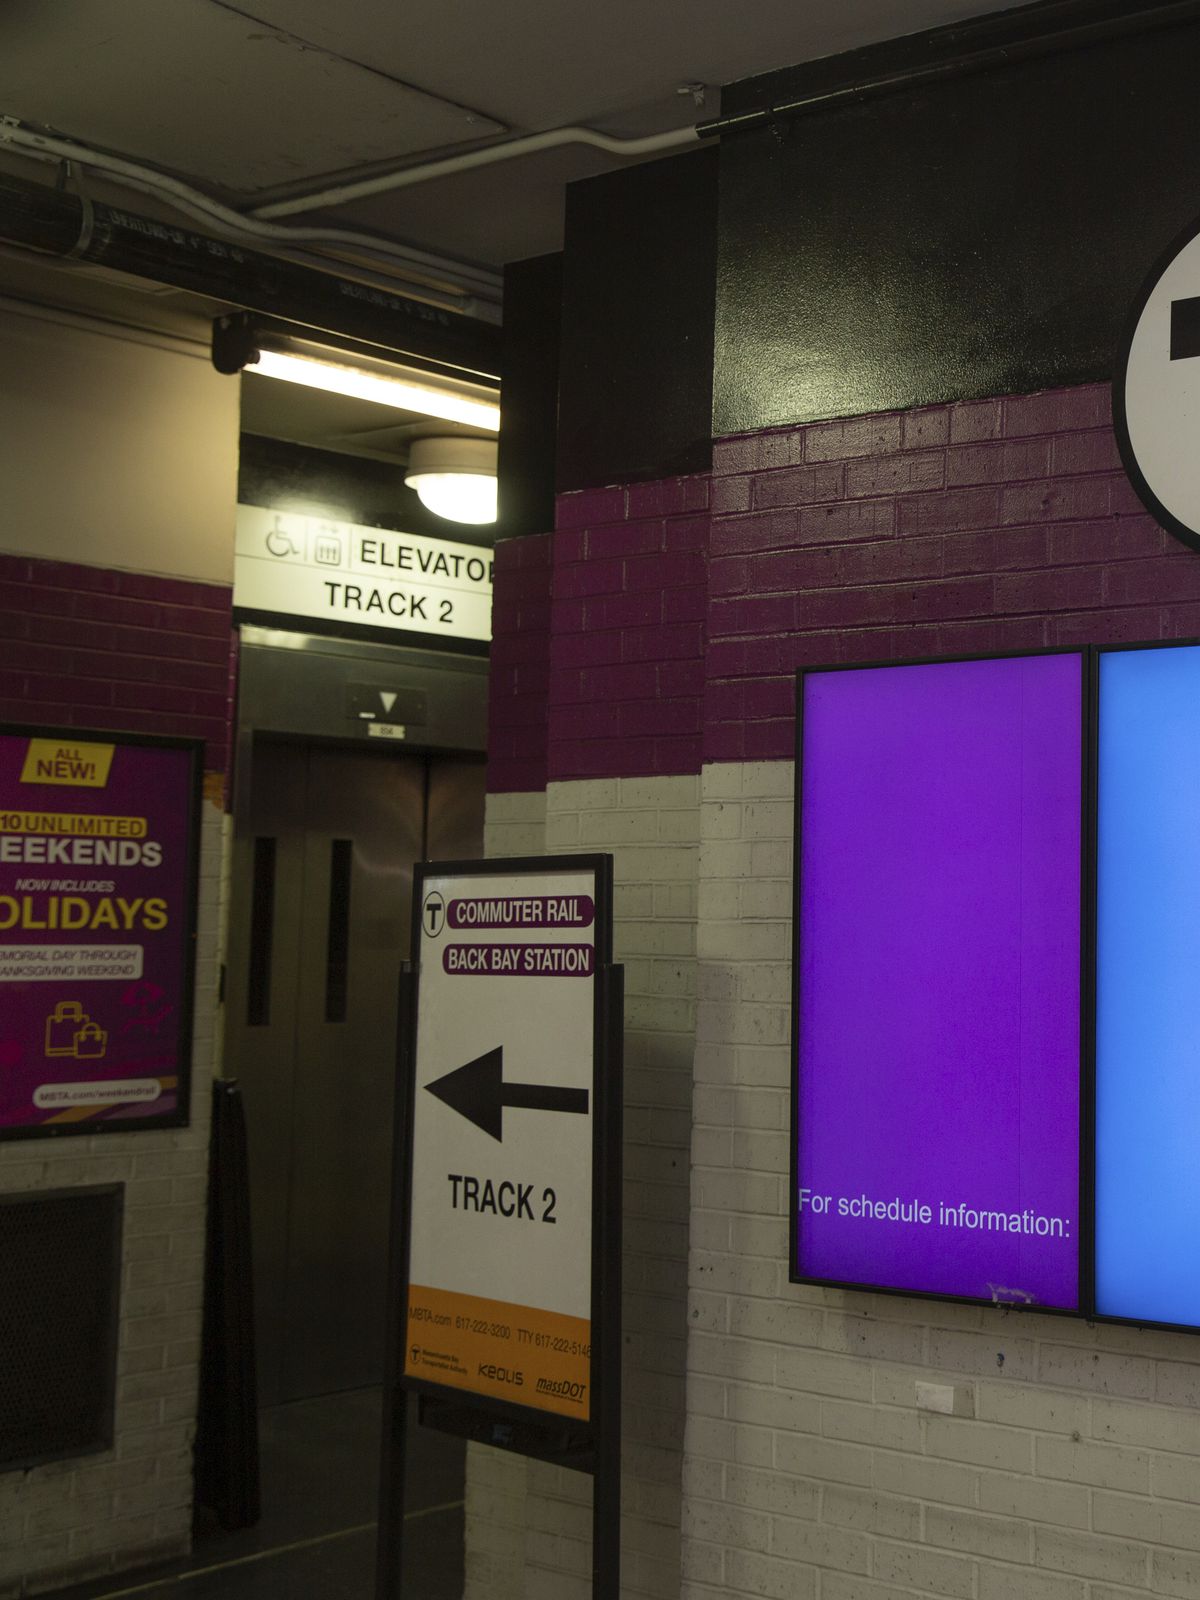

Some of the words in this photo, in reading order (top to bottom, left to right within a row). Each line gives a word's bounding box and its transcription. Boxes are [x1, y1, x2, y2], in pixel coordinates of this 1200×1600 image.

[325, 582, 427, 620] TRACK
[439, 600, 453, 623] 2
[56, 749, 82, 761] ALL
[37, 760, 96, 780] NEW!
[25, 815, 143, 837] UNLIMITED
[0, 835, 163, 867] EEKENDS
[15, 878, 50, 892] NOW
[49, 879, 116, 893] INCLUDES
[0, 895, 168, 930] OLIDAYS
[456, 900, 542, 924] COMMUTER
[547, 899, 583, 922] RAIL
[52, 951, 77, 961] DAY
[80, 950, 138, 961] THROUGH
[448, 948, 488, 970] BACK
[491, 949, 521, 970] BAY
[524, 948, 589, 971] STATION
[77, 965, 135, 977] WEEKEND
[448, 1174, 534, 1220] TRACK
[542, 1188, 556, 1224] 2
[799, 1188, 832, 1214] For
[838, 1194, 932, 1224] schedule
[939, 1201, 1070, 1238] information:
[409, 1307, 451, 1326] MBTA.com
[456, 1315, 511, 1339] 617-222-3200
[517, 1328, 535, 1347] TTY
[536, 1377, 586, 1399] massDOT
